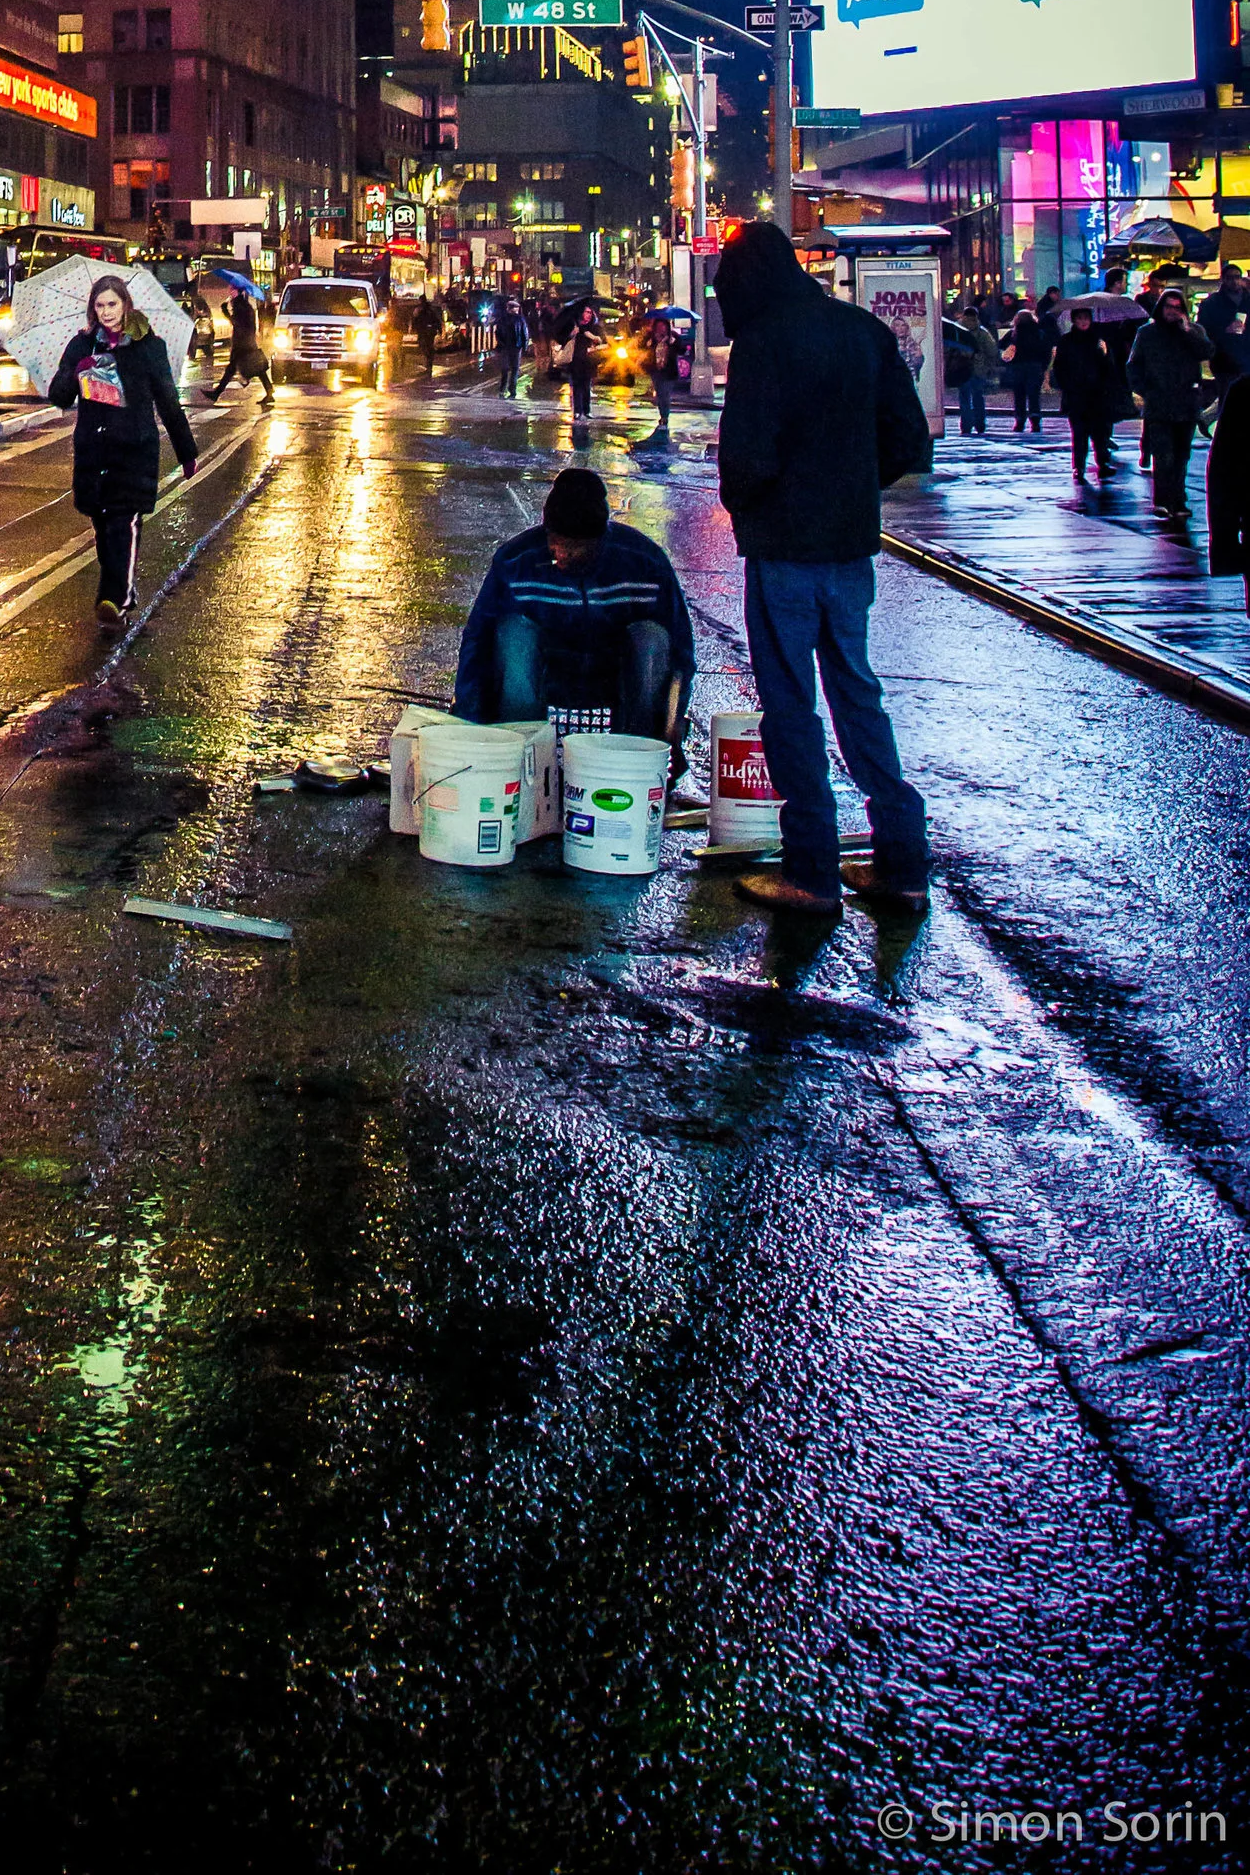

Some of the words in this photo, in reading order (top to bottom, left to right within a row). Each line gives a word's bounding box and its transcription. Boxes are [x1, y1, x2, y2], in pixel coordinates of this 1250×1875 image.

[507, 1, 529, 20] W
[533, 1, 566, 21] 48
[571, 1, 596, 21] St
[757, 14, 776, 24] ON
[789, 14, 812, 24] WAY
[12, 76, 32, 105] york
[32, 83, 58, 113] sports
[58, 90, 79, 122] clubs
[1127, 94, 1202, 114] SHERWOOD
[366, 220, 384, 232] DELI
[886, 261, 912, 269] TITAN
[870, 291, 926, 305] JOAN
[872, 305, 927, 316] RIVERS
